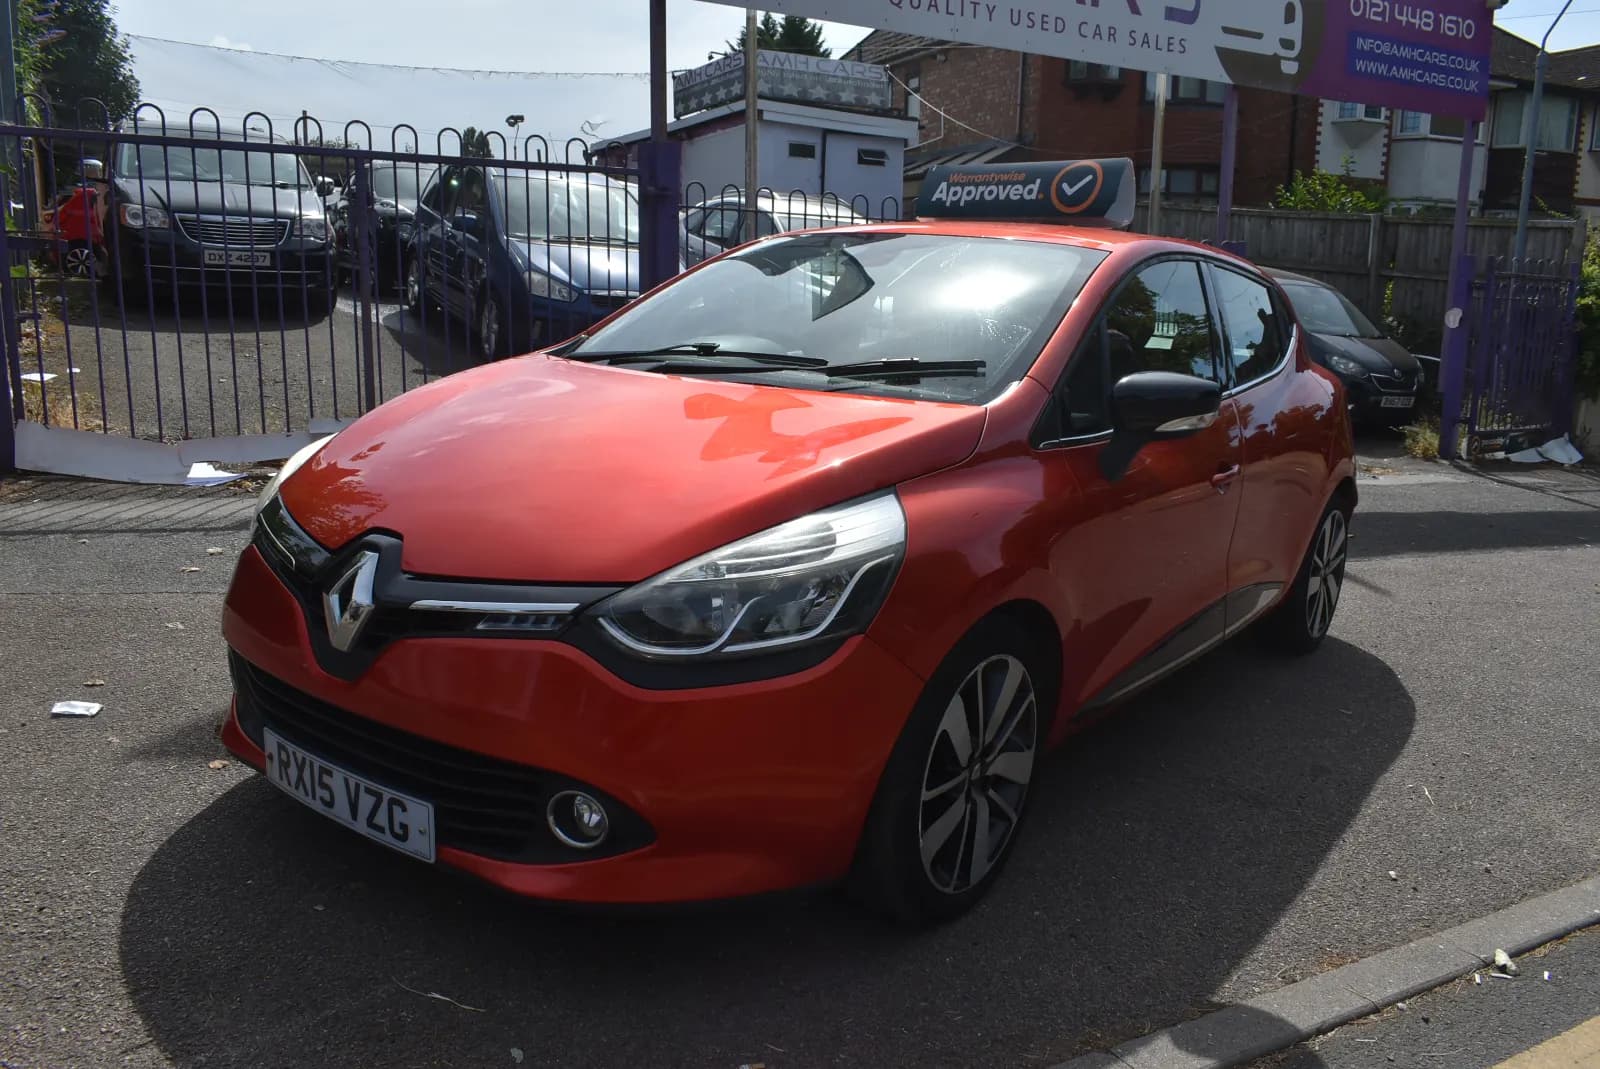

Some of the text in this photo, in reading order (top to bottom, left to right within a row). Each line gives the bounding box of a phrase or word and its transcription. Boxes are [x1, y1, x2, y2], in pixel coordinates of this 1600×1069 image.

[1010, 8, 1066, 34] USED
[1078, 21, 1117, 43] CAR
[1128, 30, 1187, 54] SALES
[1350, 0, 1475, 39] 0121 448 1610
[757, 52, 809, 70] AMH
[816, 58, 883, 80] CARS
[1356, 37, 1480, 72] INFO@AMHCARS.CO.UK
[676, 69, 702, 89] AMH
[705, 55, 742, 77] CARS
[1355, 59, 1479, 92] WWW.AMHCARS.CO.UK
[932, 178, 1045, 207] Approved.
[950, 171, 1026, 184] Warrantywise
[276, 741, 409, 843] RX15 VZG
